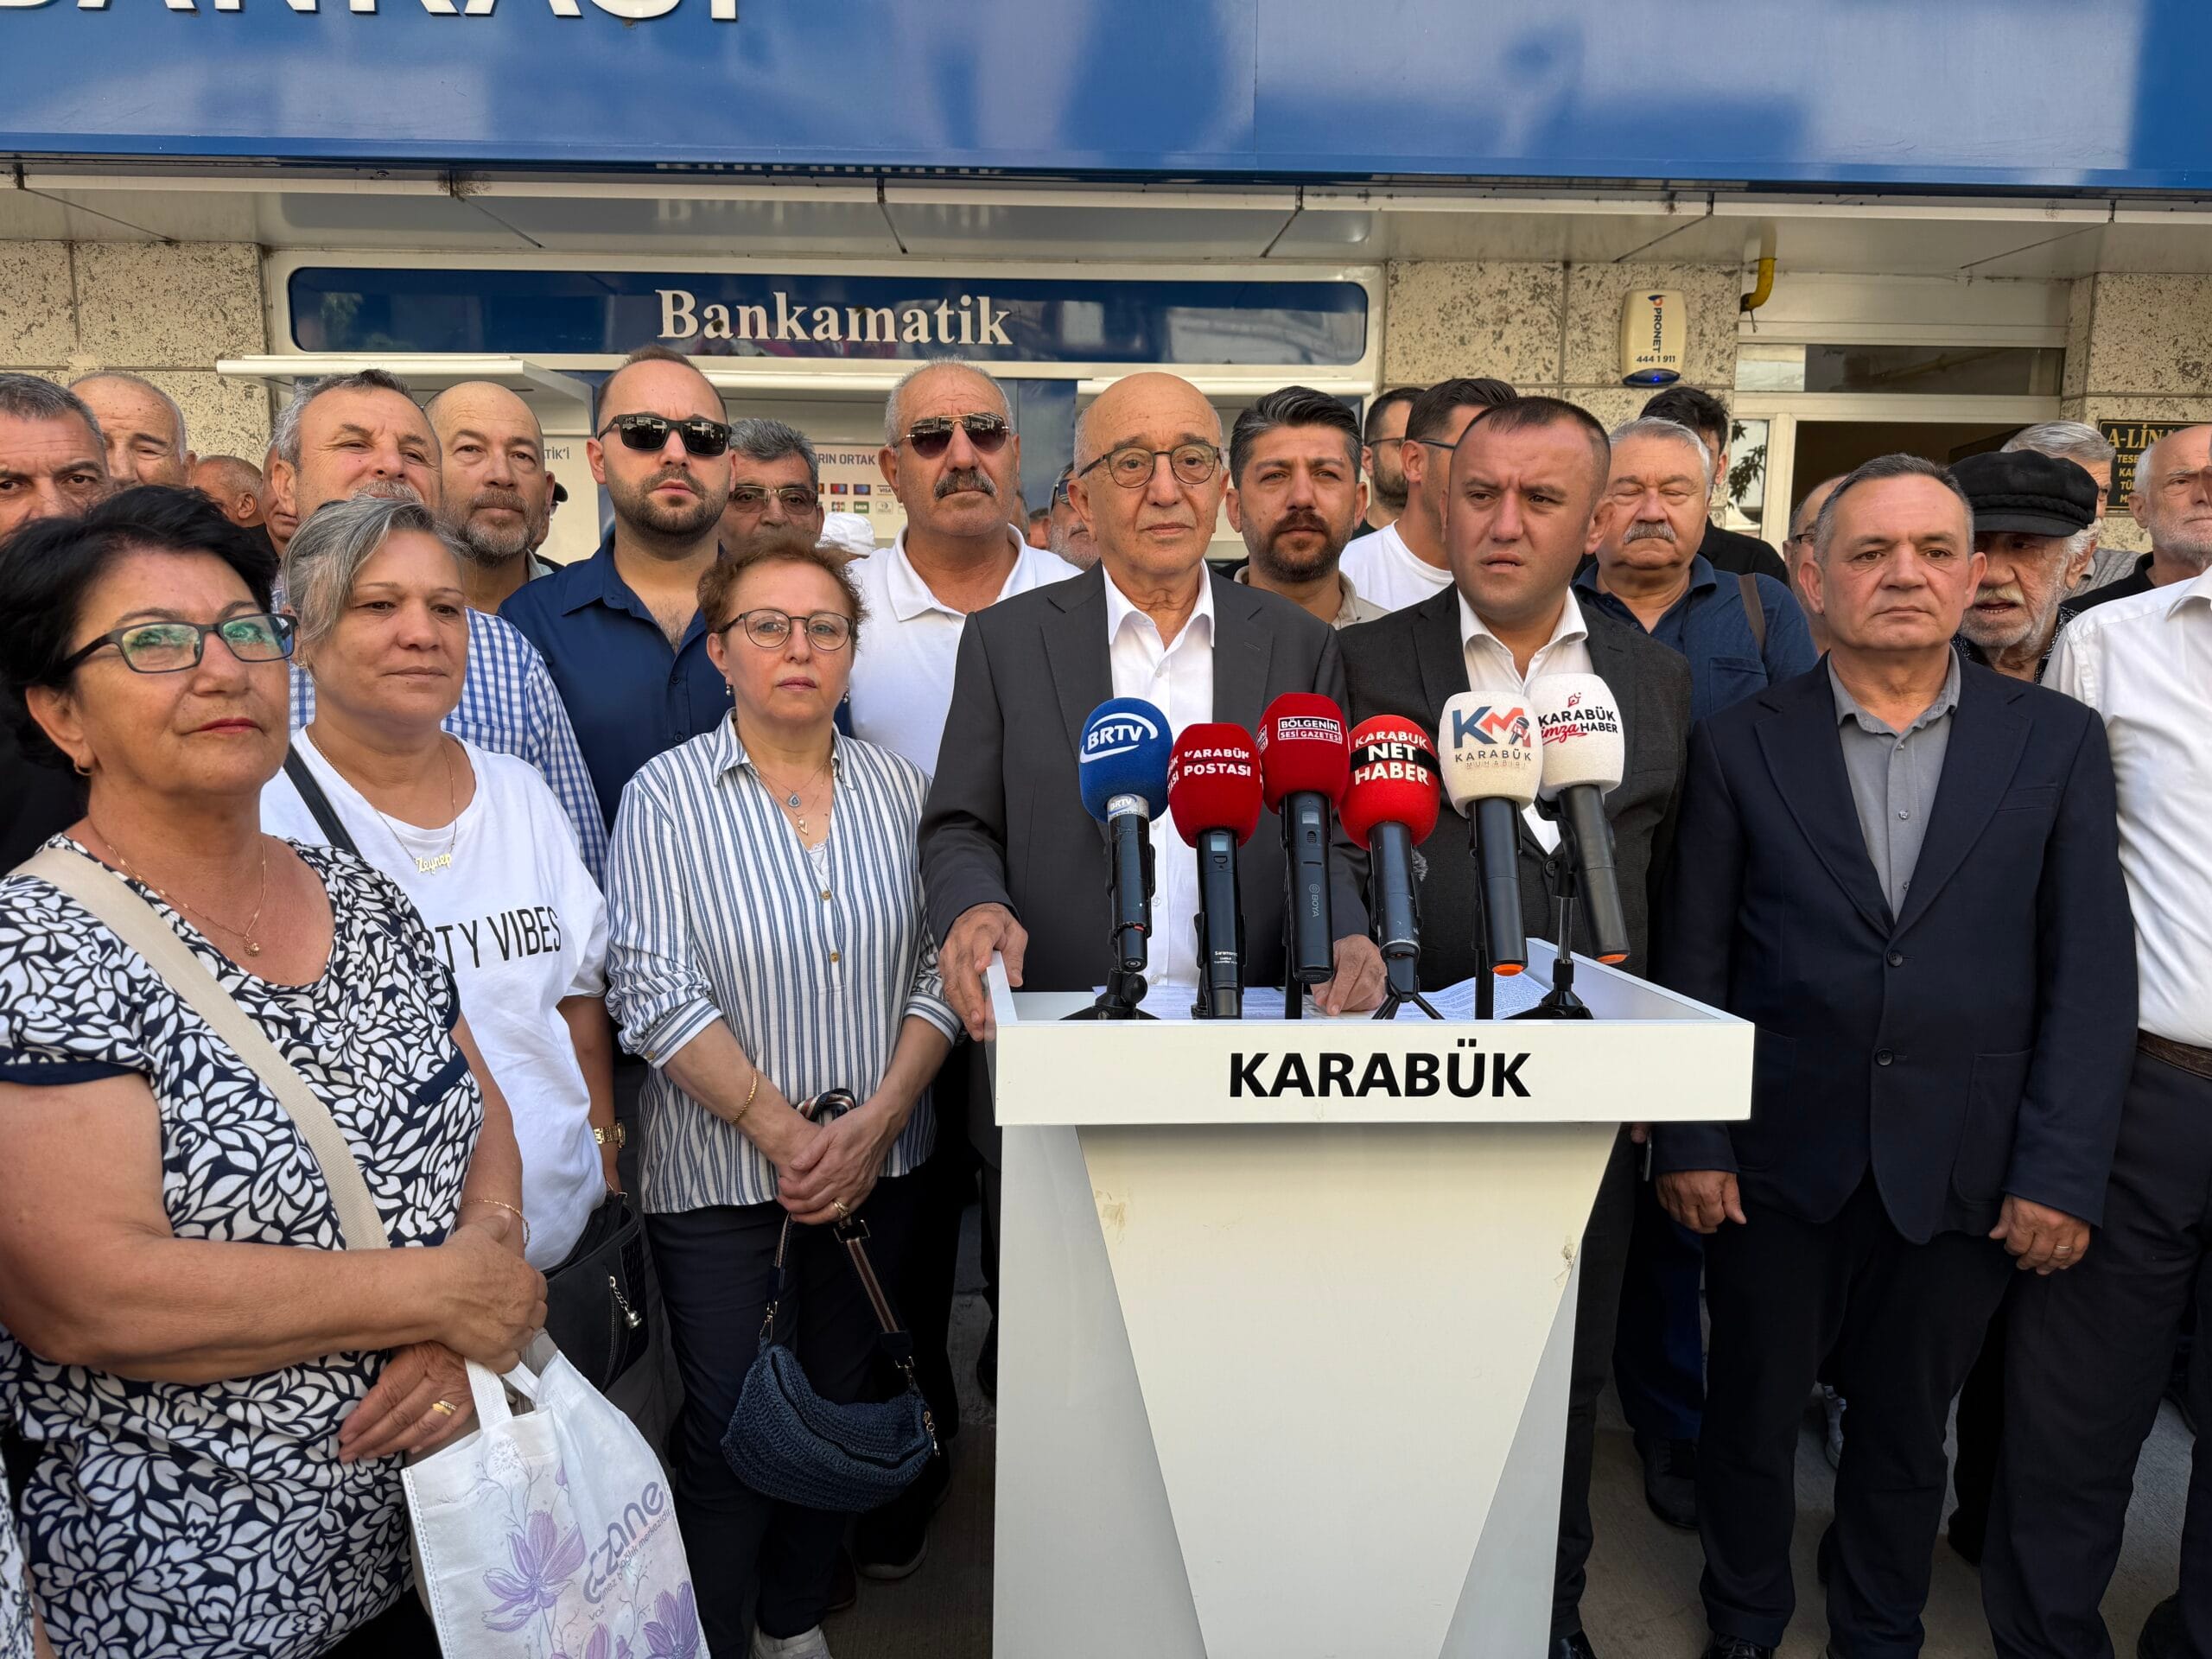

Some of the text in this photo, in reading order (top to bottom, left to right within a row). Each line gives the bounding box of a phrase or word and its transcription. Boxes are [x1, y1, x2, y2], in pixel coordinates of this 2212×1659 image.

[654, 289, 1014, 346] Bankamatik
[1653, 307, 1662, 353] PRONET
[544, 446, 570, 460] TİK'İ
[817, 453, 875, 466] RIN ORTAK
[1281, 718, 1338, 731] BÖLGENİN
[1537, 706, 1617, 728] KARABÜK
[1087, 724, 1144, 752] BRTV
[1280, 729, 1299, 739] SESİ
[1355, 731, 1428, 749] KARABUK
[1541, 722, 1618, 744] imza HABER
[1368, 742, 1416, 761] NET
[1455, 748, 1532, 763] KARABÜK
[1183, 763, 1252, 777] POSTASI
[1354, 761, 1429, 785] HABER
[1109, 798, 1133, 810] BRTV
[415, 853, 452, 874] Zeynep
[1312, 894, 1320, 918] BOYA
[486, 906, 562, 962] VIBES
[1230, 1039, 1531, 1098] KARABÜK
